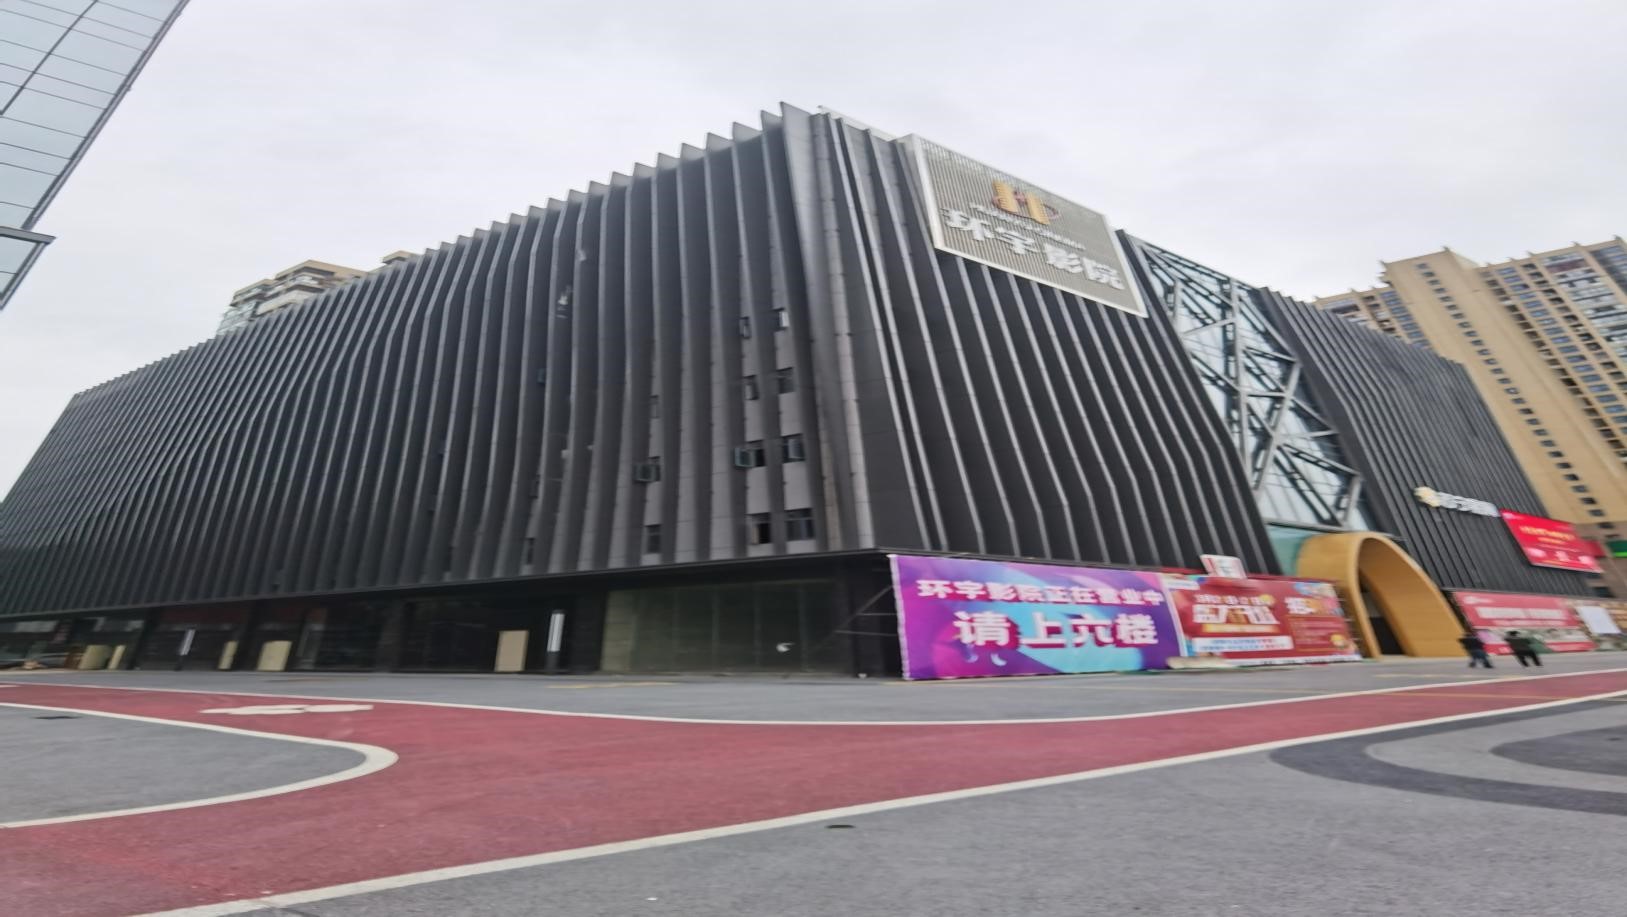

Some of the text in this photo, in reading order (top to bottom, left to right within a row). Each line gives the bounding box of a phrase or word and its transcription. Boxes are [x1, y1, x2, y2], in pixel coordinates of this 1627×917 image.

[941, 208, 1125, 290] 环宇影院
[917, 579, 1163, 606] 环宇影院正在营业中
[953, 611, 1158, 646] 请上六楼
